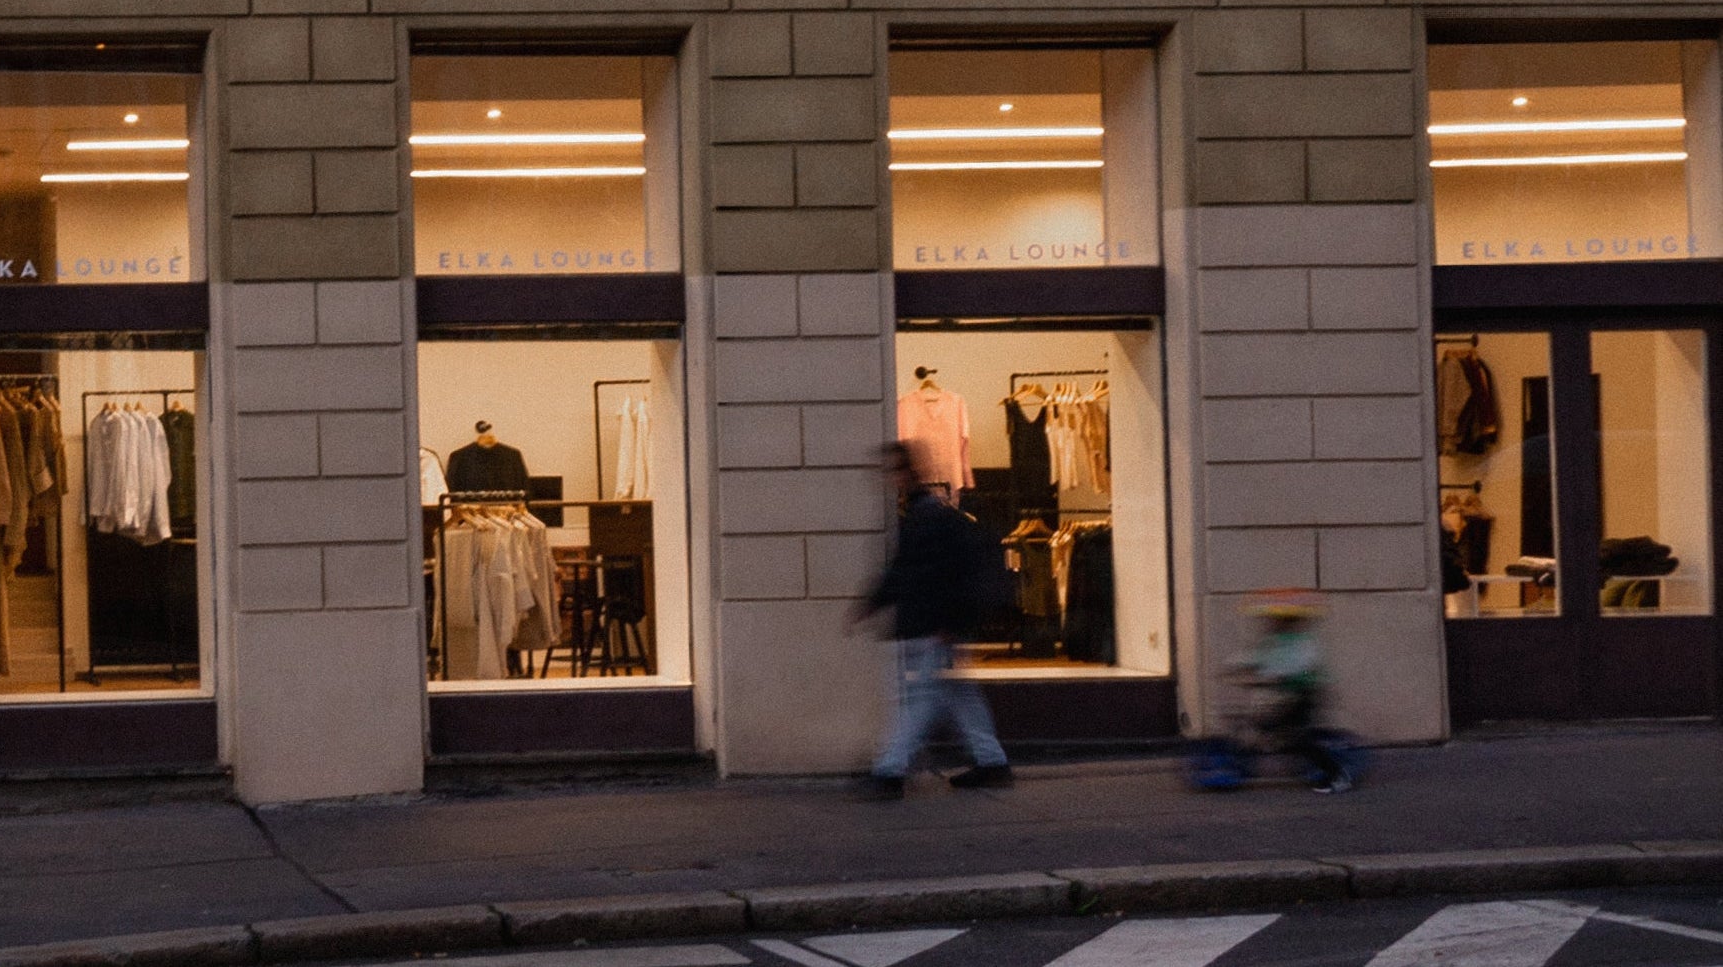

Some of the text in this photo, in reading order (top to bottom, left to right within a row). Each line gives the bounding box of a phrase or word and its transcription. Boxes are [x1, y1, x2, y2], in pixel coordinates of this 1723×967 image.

[916, 241, 1131, 263] ELKA LOUNGE
[1462, 235, 1699, 259] ELKA LOUNGE
[56, 255, 183, 277] LOUNGE
[439, 249, 656, 269] ELKA LOUNGE
